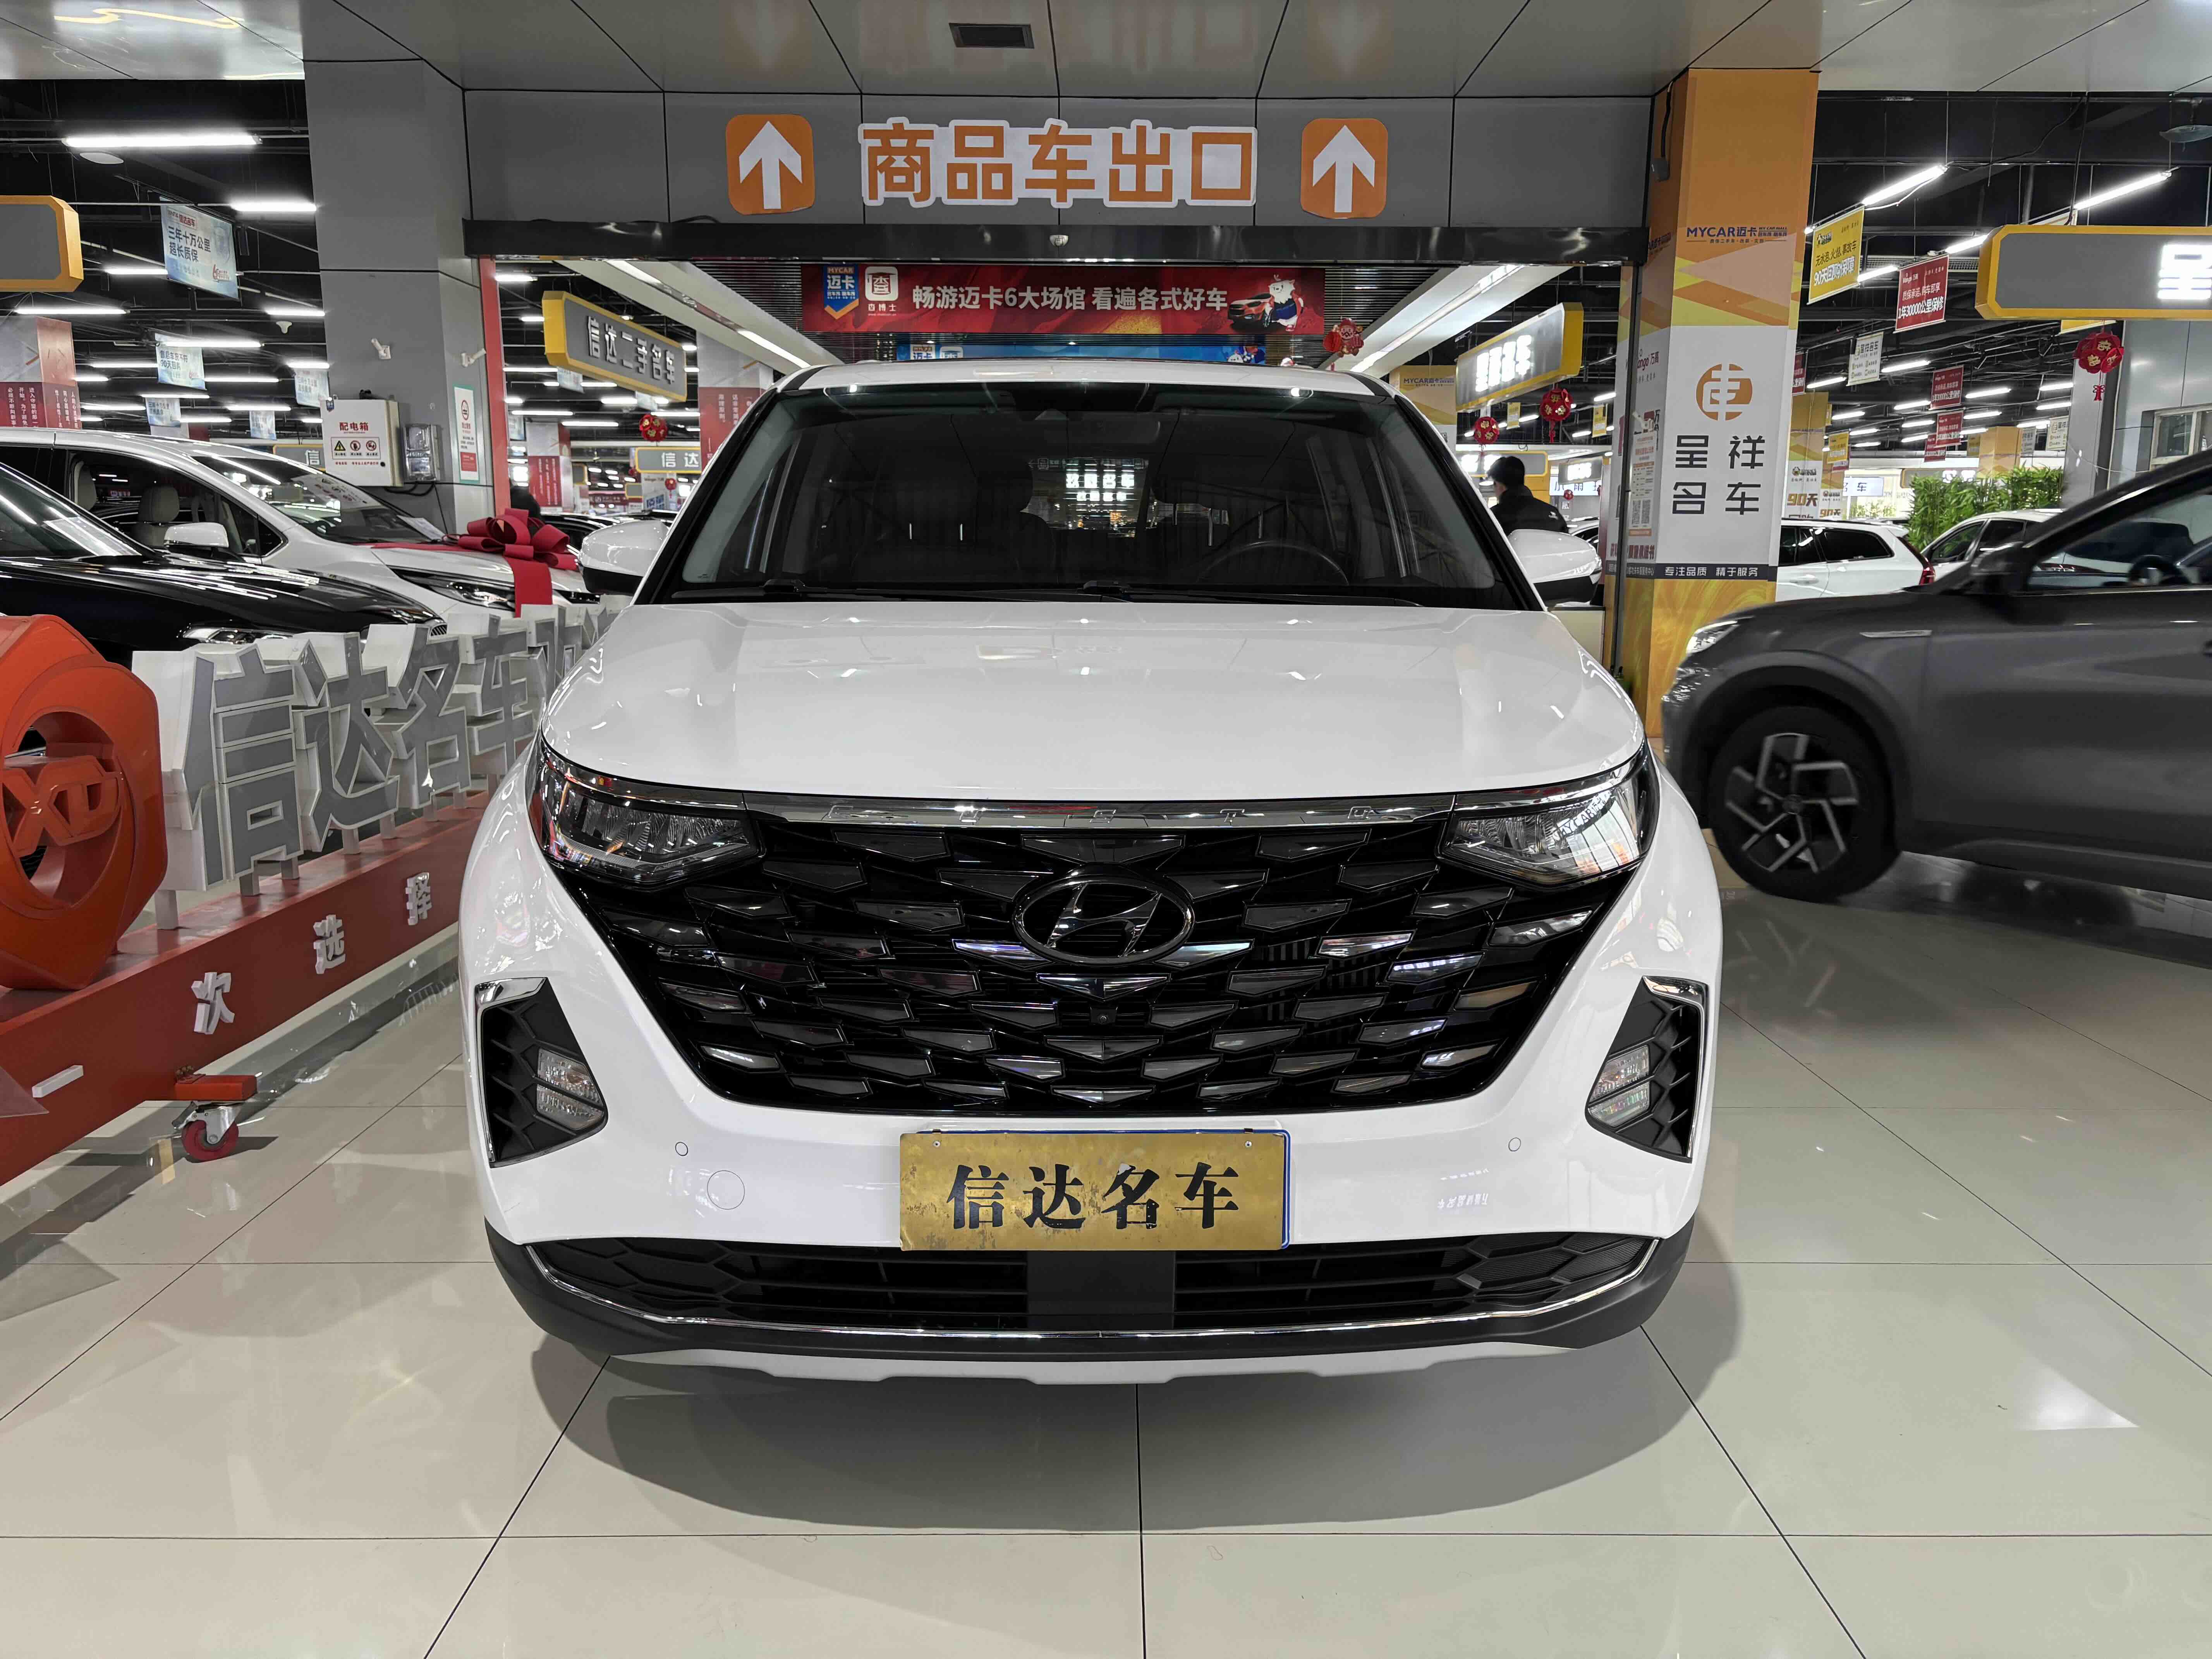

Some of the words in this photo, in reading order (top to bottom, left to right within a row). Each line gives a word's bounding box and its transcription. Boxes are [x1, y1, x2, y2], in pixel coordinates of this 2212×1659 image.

[862, 122, 1254, 203] 商品车出口
[168, 226, 211, 252] 三年十万公里
[169, 242, 198, 263] 超长质保
[827, 275, 855, 290] 迈卡
[912, 285, 1085, 310] 畅游迈卡6大场馆
[1092, 286, 1228, 311] 看遍各式好车
[587, 315, 676, 384] 信达二手名车
[340, 422, 369, 431] 配电箱
[661, 452, 699, 468] 信达
[1674, 435, 1765, 469] 呈祥
[1671, 481, 1761, 515] 名车
[1787, 493, 1818, 507] 90天
[1665, 567, 1707, 576] 专注品质
[1716, 567, 1758, 577] 精于服务
[32, 871, 431, 1098] 一次选择
[946, 1162, 1239, 1230] 信达名车
